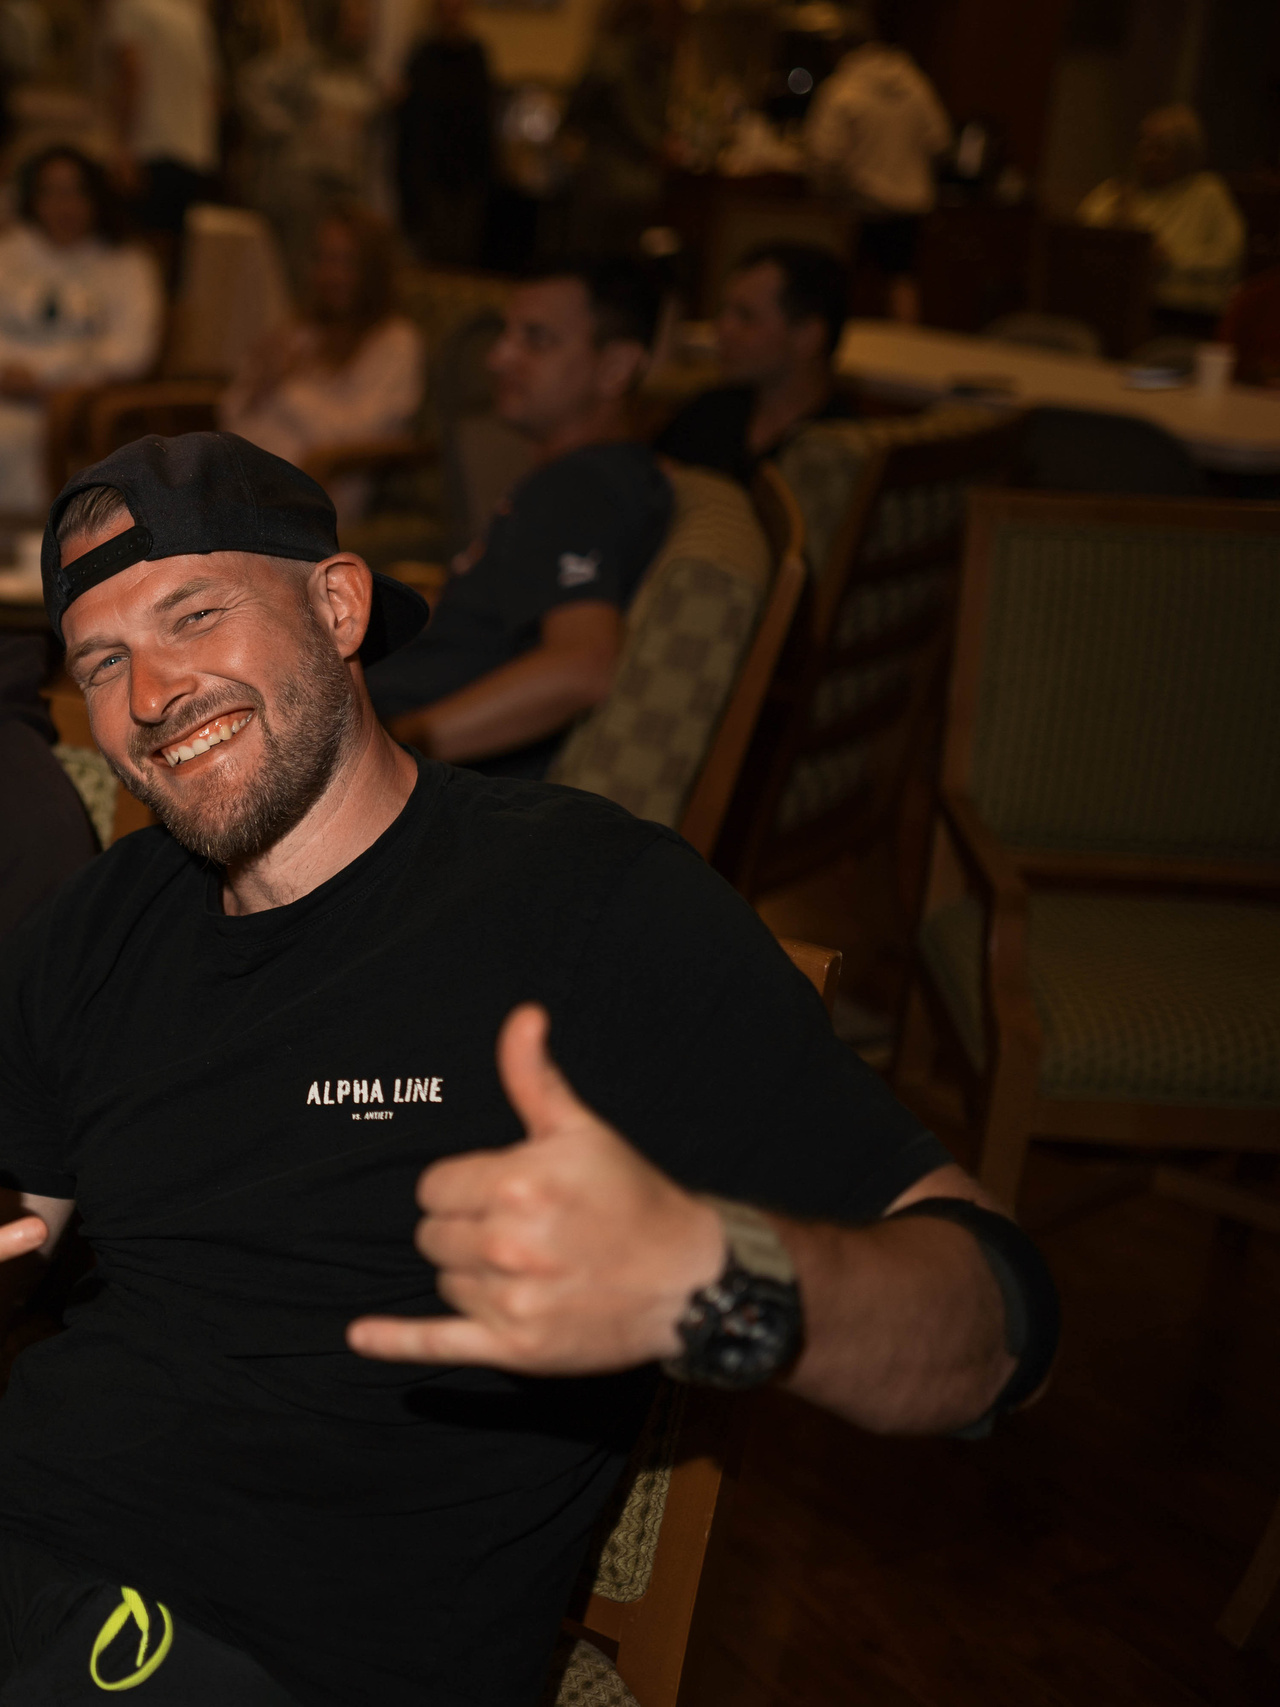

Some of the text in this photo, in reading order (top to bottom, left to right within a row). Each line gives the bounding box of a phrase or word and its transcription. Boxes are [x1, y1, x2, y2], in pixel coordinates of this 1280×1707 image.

[306, 1077, 444, 1105] ALPHA LINE
[363, 1111, 394, 1120] ANXIETY
